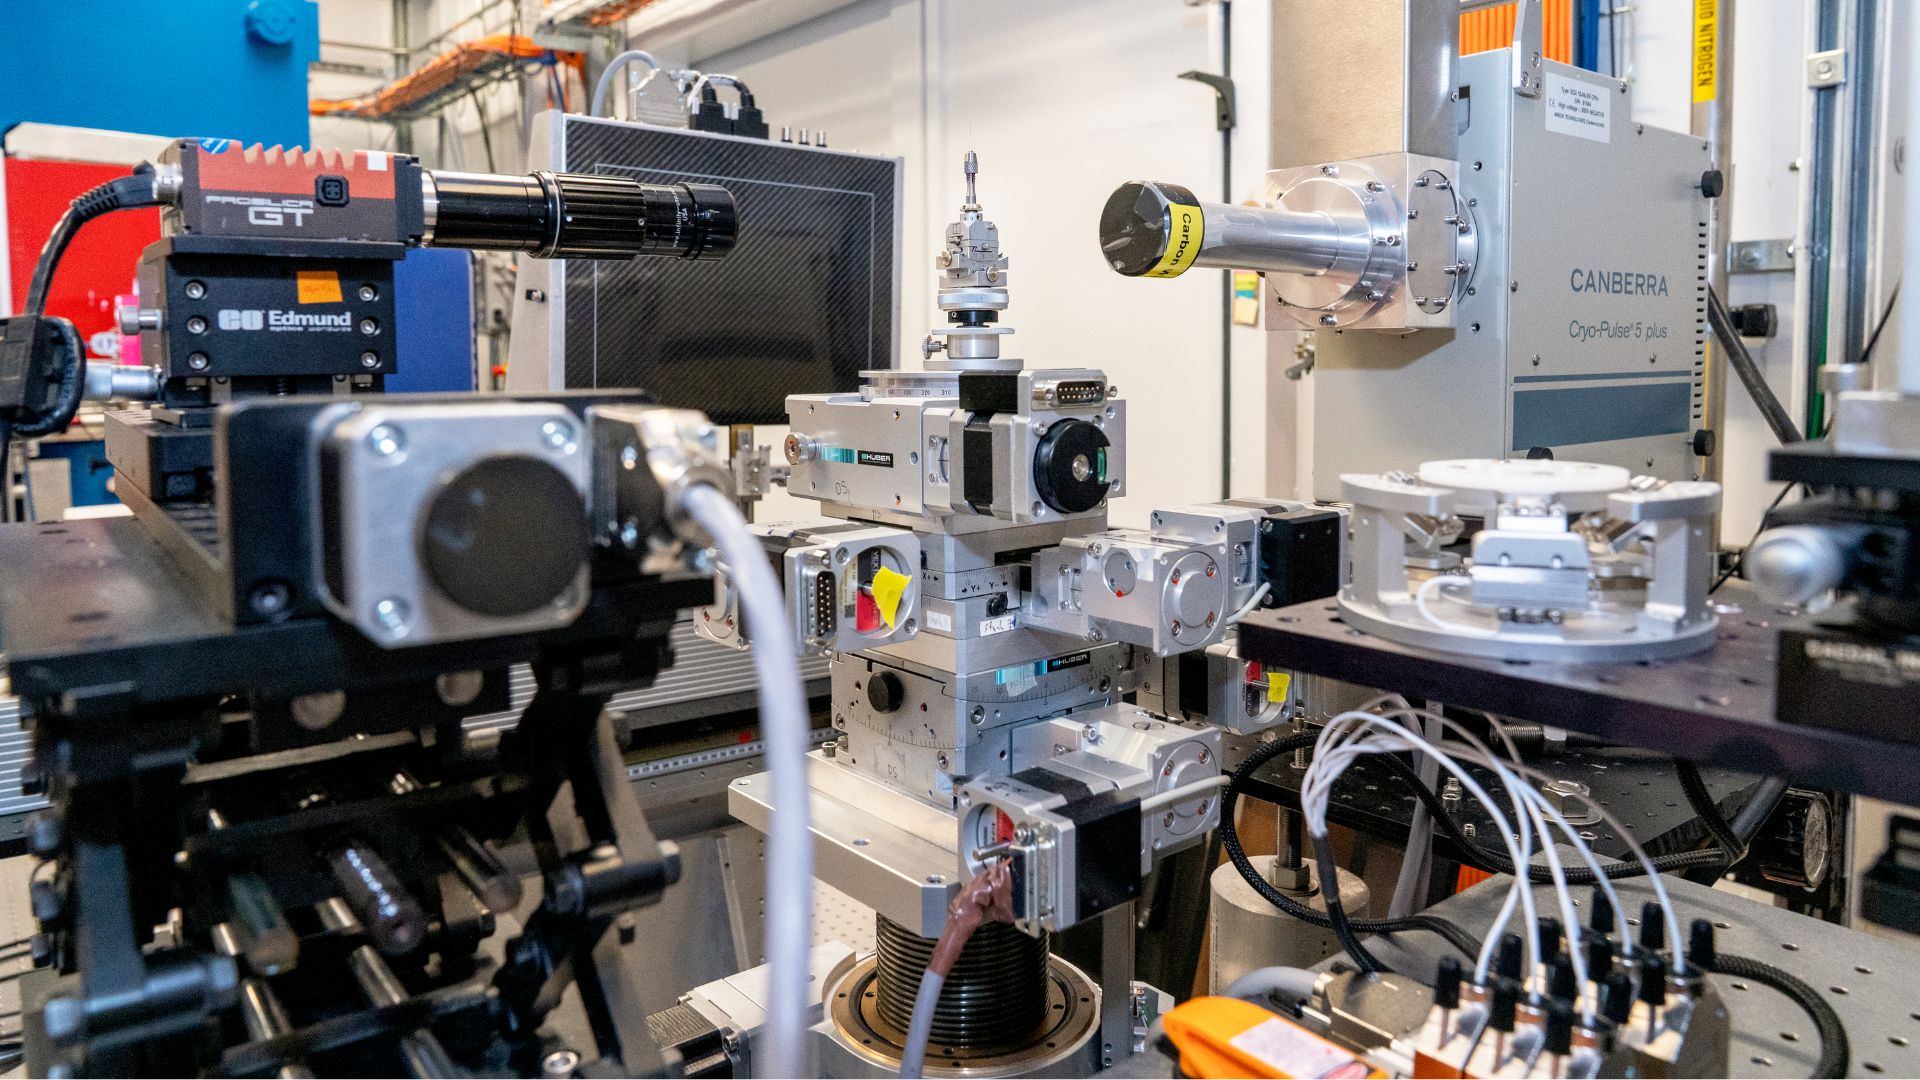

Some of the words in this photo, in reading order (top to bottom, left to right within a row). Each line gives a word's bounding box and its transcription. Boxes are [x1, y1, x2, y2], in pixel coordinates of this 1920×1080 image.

[1698, 23, 1713, 87] NITROGEN
[248, 206, 314, 226] GT
[1169, 213, 1191, 265] Carbon
[1570, 268, 1669, 296] CANBERRA
[268, 310, 352, 326] Edmund
[1635, 322, 1642, 338] 5
[1645, 321, 1668, 341] plus
[867, 454, 890, 462] HUBER
[872, 550, 880, 575] VEXT
[922, 572, 931, 580] X+
[971, 584, 981, 592] Y+
[1058, 653, 1088, 666] HUBER
